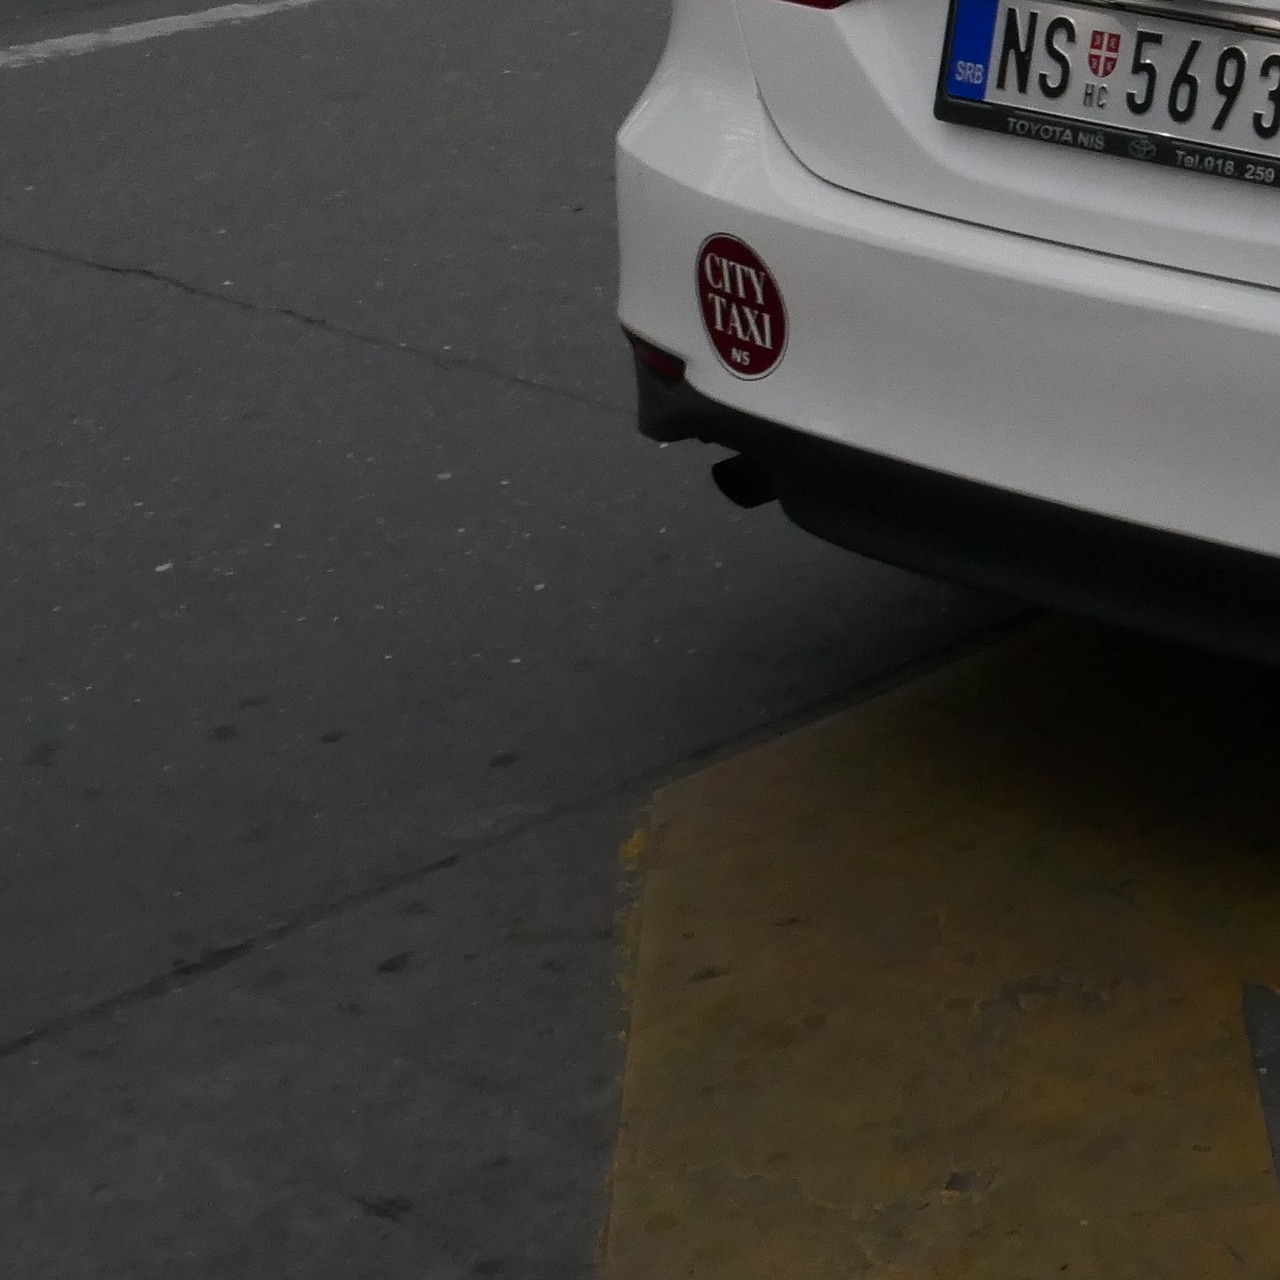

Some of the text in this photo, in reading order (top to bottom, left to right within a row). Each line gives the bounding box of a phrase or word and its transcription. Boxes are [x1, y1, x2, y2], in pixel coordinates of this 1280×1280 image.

[955, 60, 984, 84] SRB
[996, 7, 1077, 99] NS
[1007, 118, 1073, 145] TOYOTA
[1244, 163, 1275, 183] 259
[705, 252, 766, 305] CITY
[707, 292, 773, 350] TAXI
[731, 347, 750, 366] NS
